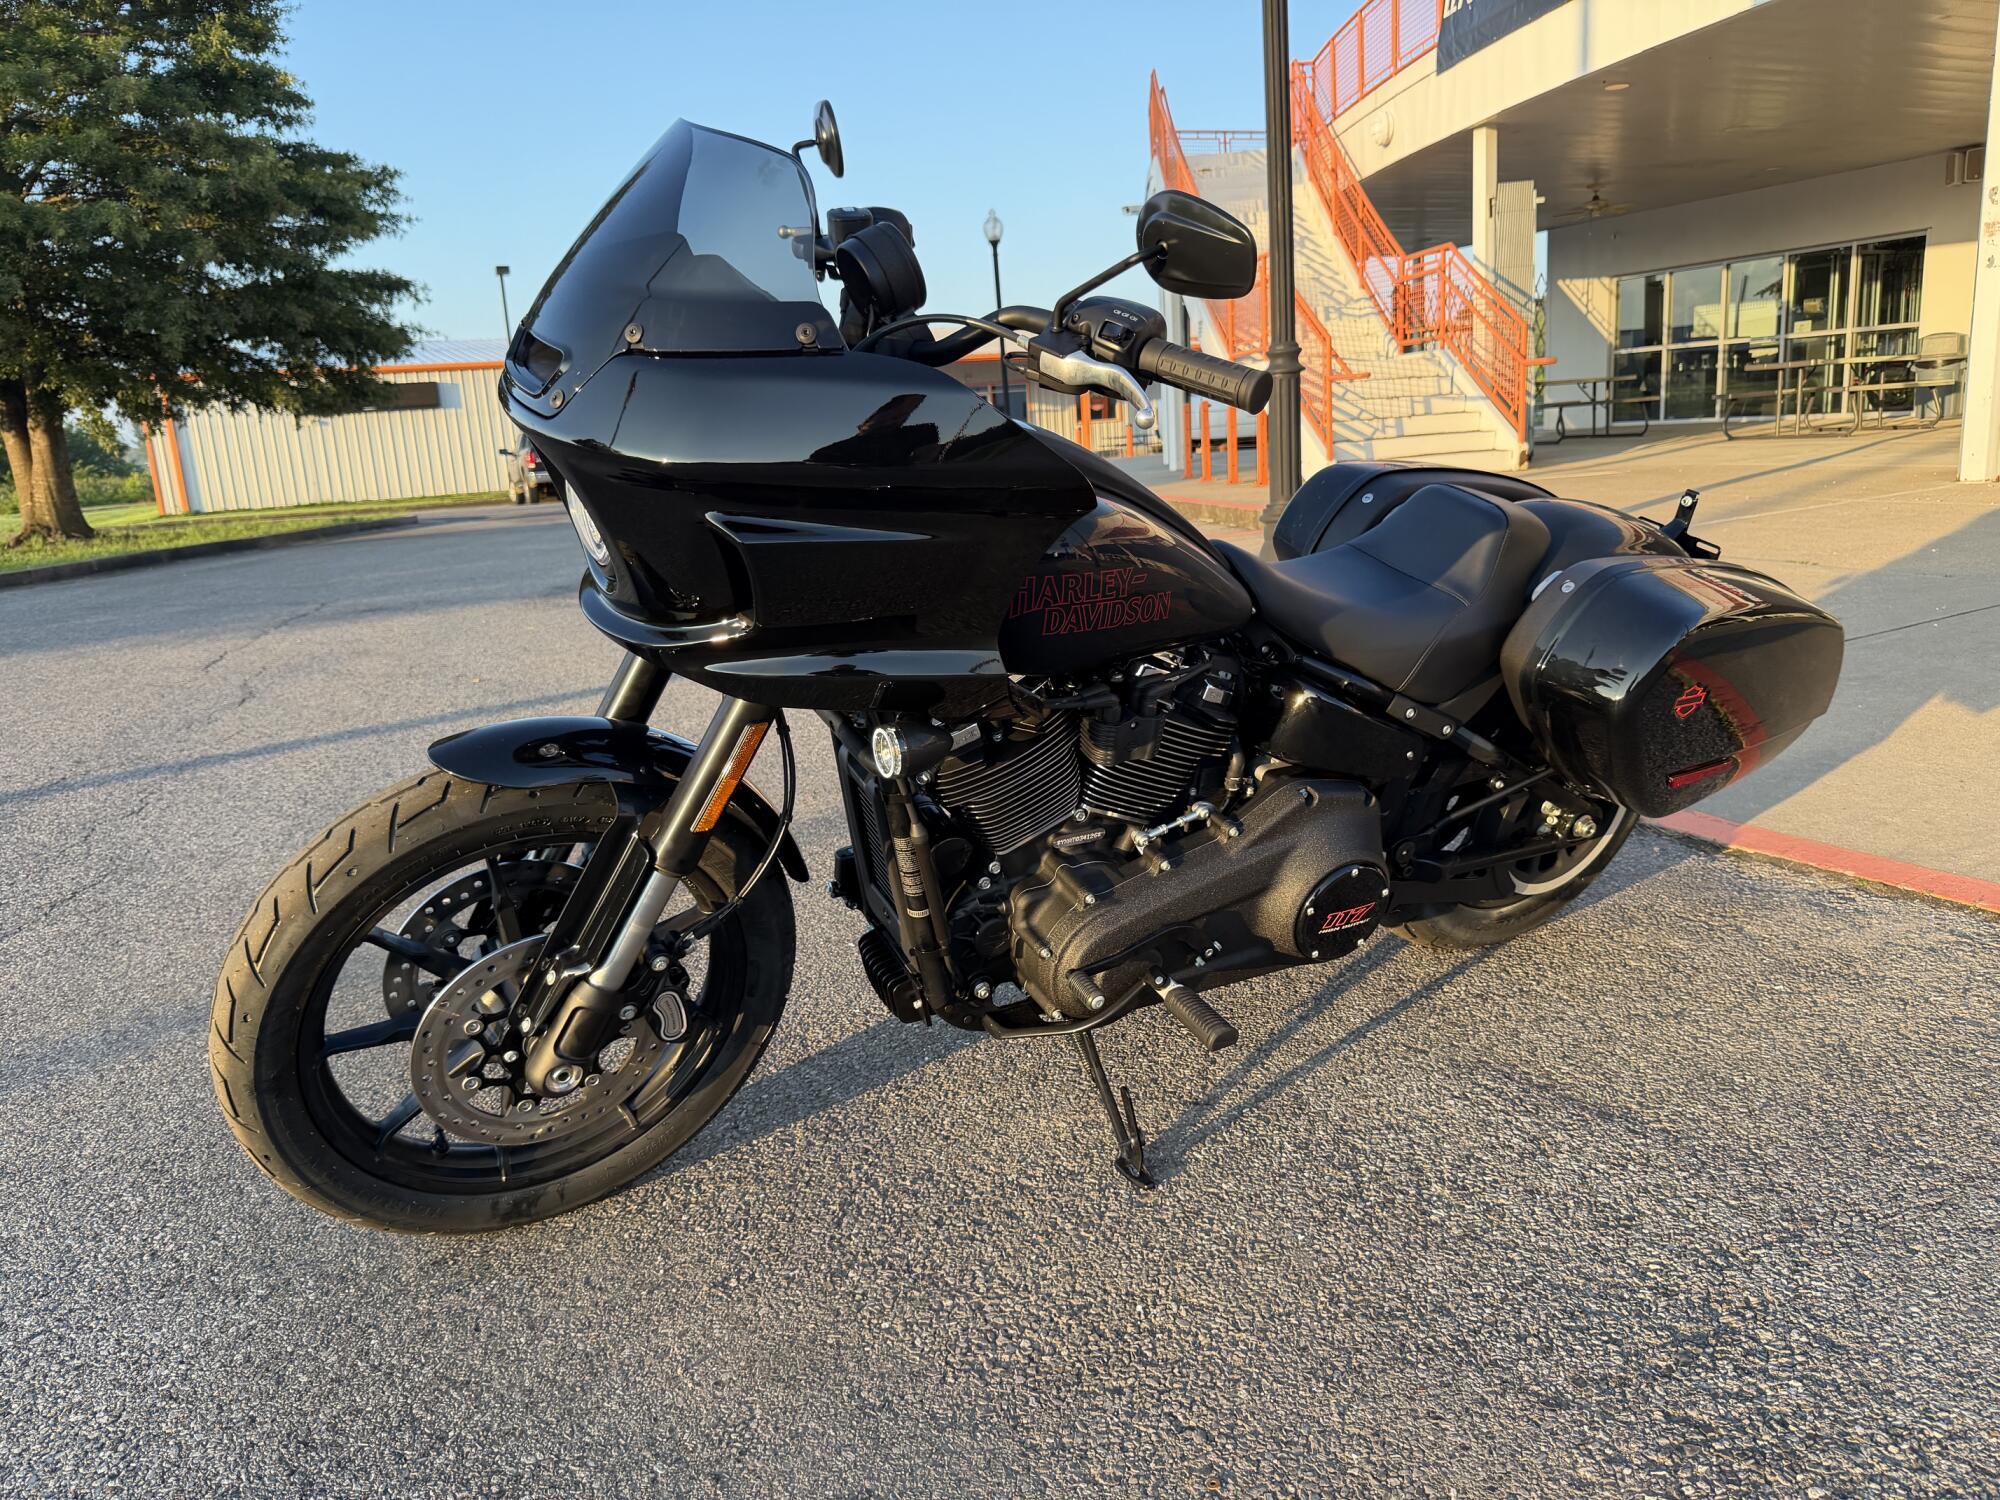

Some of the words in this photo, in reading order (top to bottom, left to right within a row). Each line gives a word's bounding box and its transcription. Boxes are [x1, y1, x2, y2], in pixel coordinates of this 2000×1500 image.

[1009, 567, 1148, 619] HARLEY-
[1042, 591, 1171, 635] DAVIDSON
[1322, 901, 1377, 929] 117
